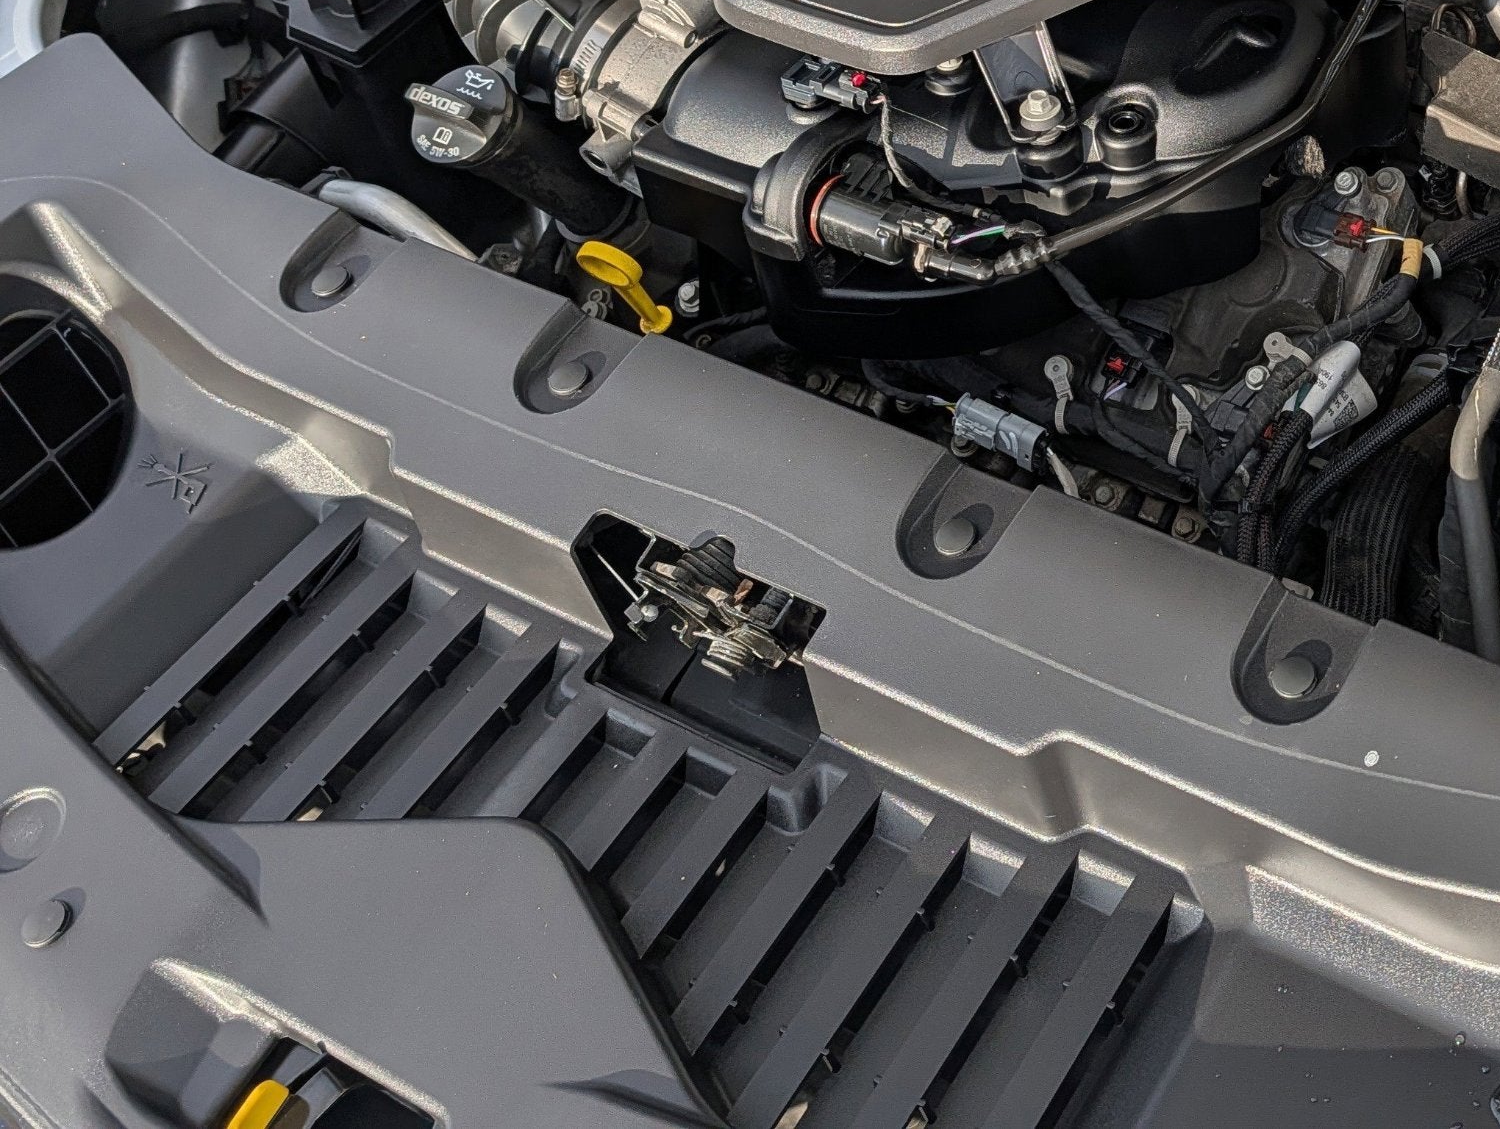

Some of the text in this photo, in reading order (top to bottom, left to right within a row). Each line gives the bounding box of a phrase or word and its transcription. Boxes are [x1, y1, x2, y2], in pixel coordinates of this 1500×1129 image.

[409, 85, 462, 114] dexos
[417, 134, 460, 158] SAE 5W-30
